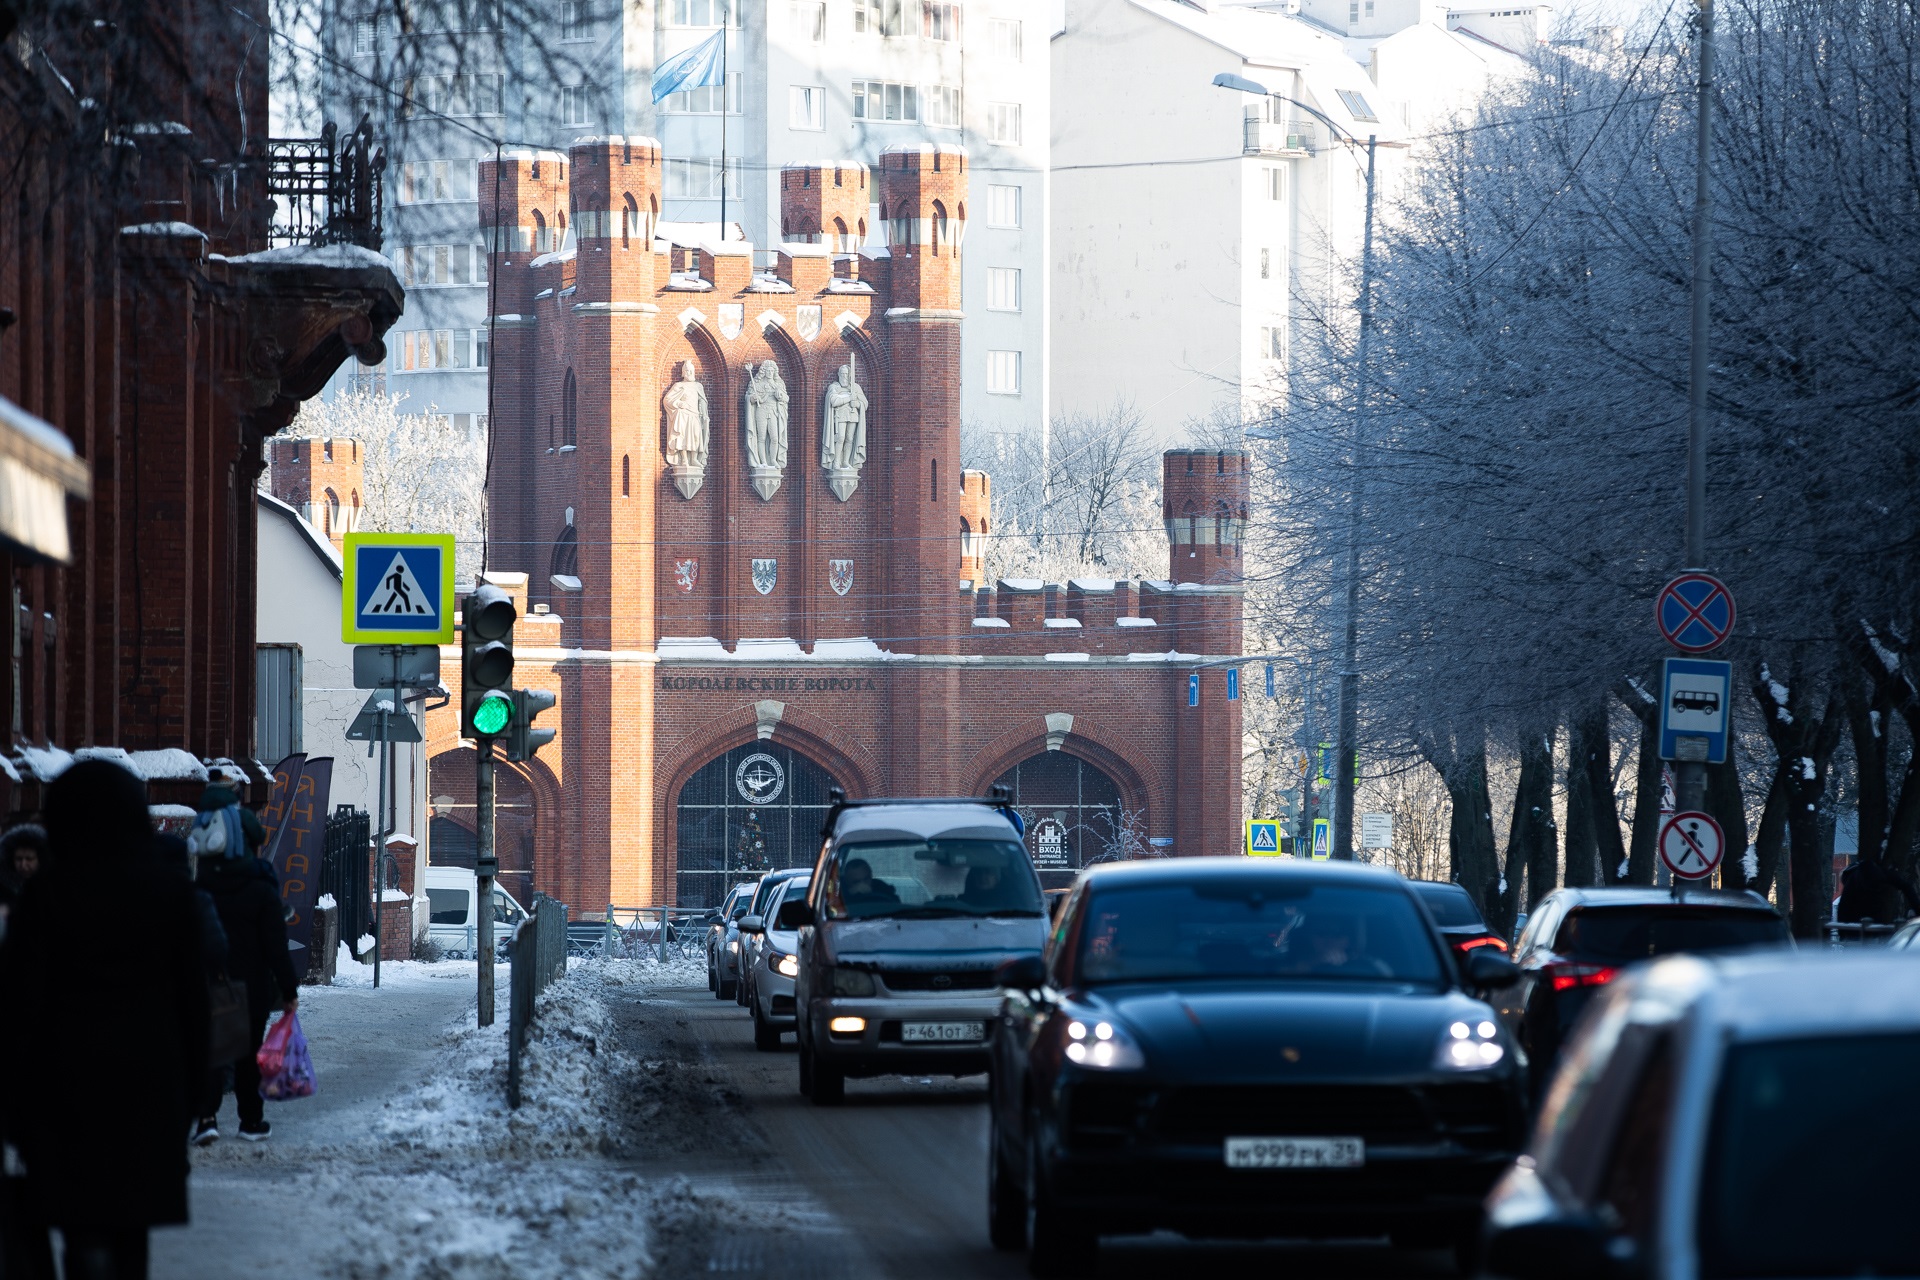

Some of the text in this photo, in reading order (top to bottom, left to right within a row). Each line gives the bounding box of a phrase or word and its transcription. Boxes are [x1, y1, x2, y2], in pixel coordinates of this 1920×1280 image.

[662, 677, 876, 691] КОРОЛЕВСКИЕ ВОРОТА
[1039, 846, 1061, 854] ВХОД
